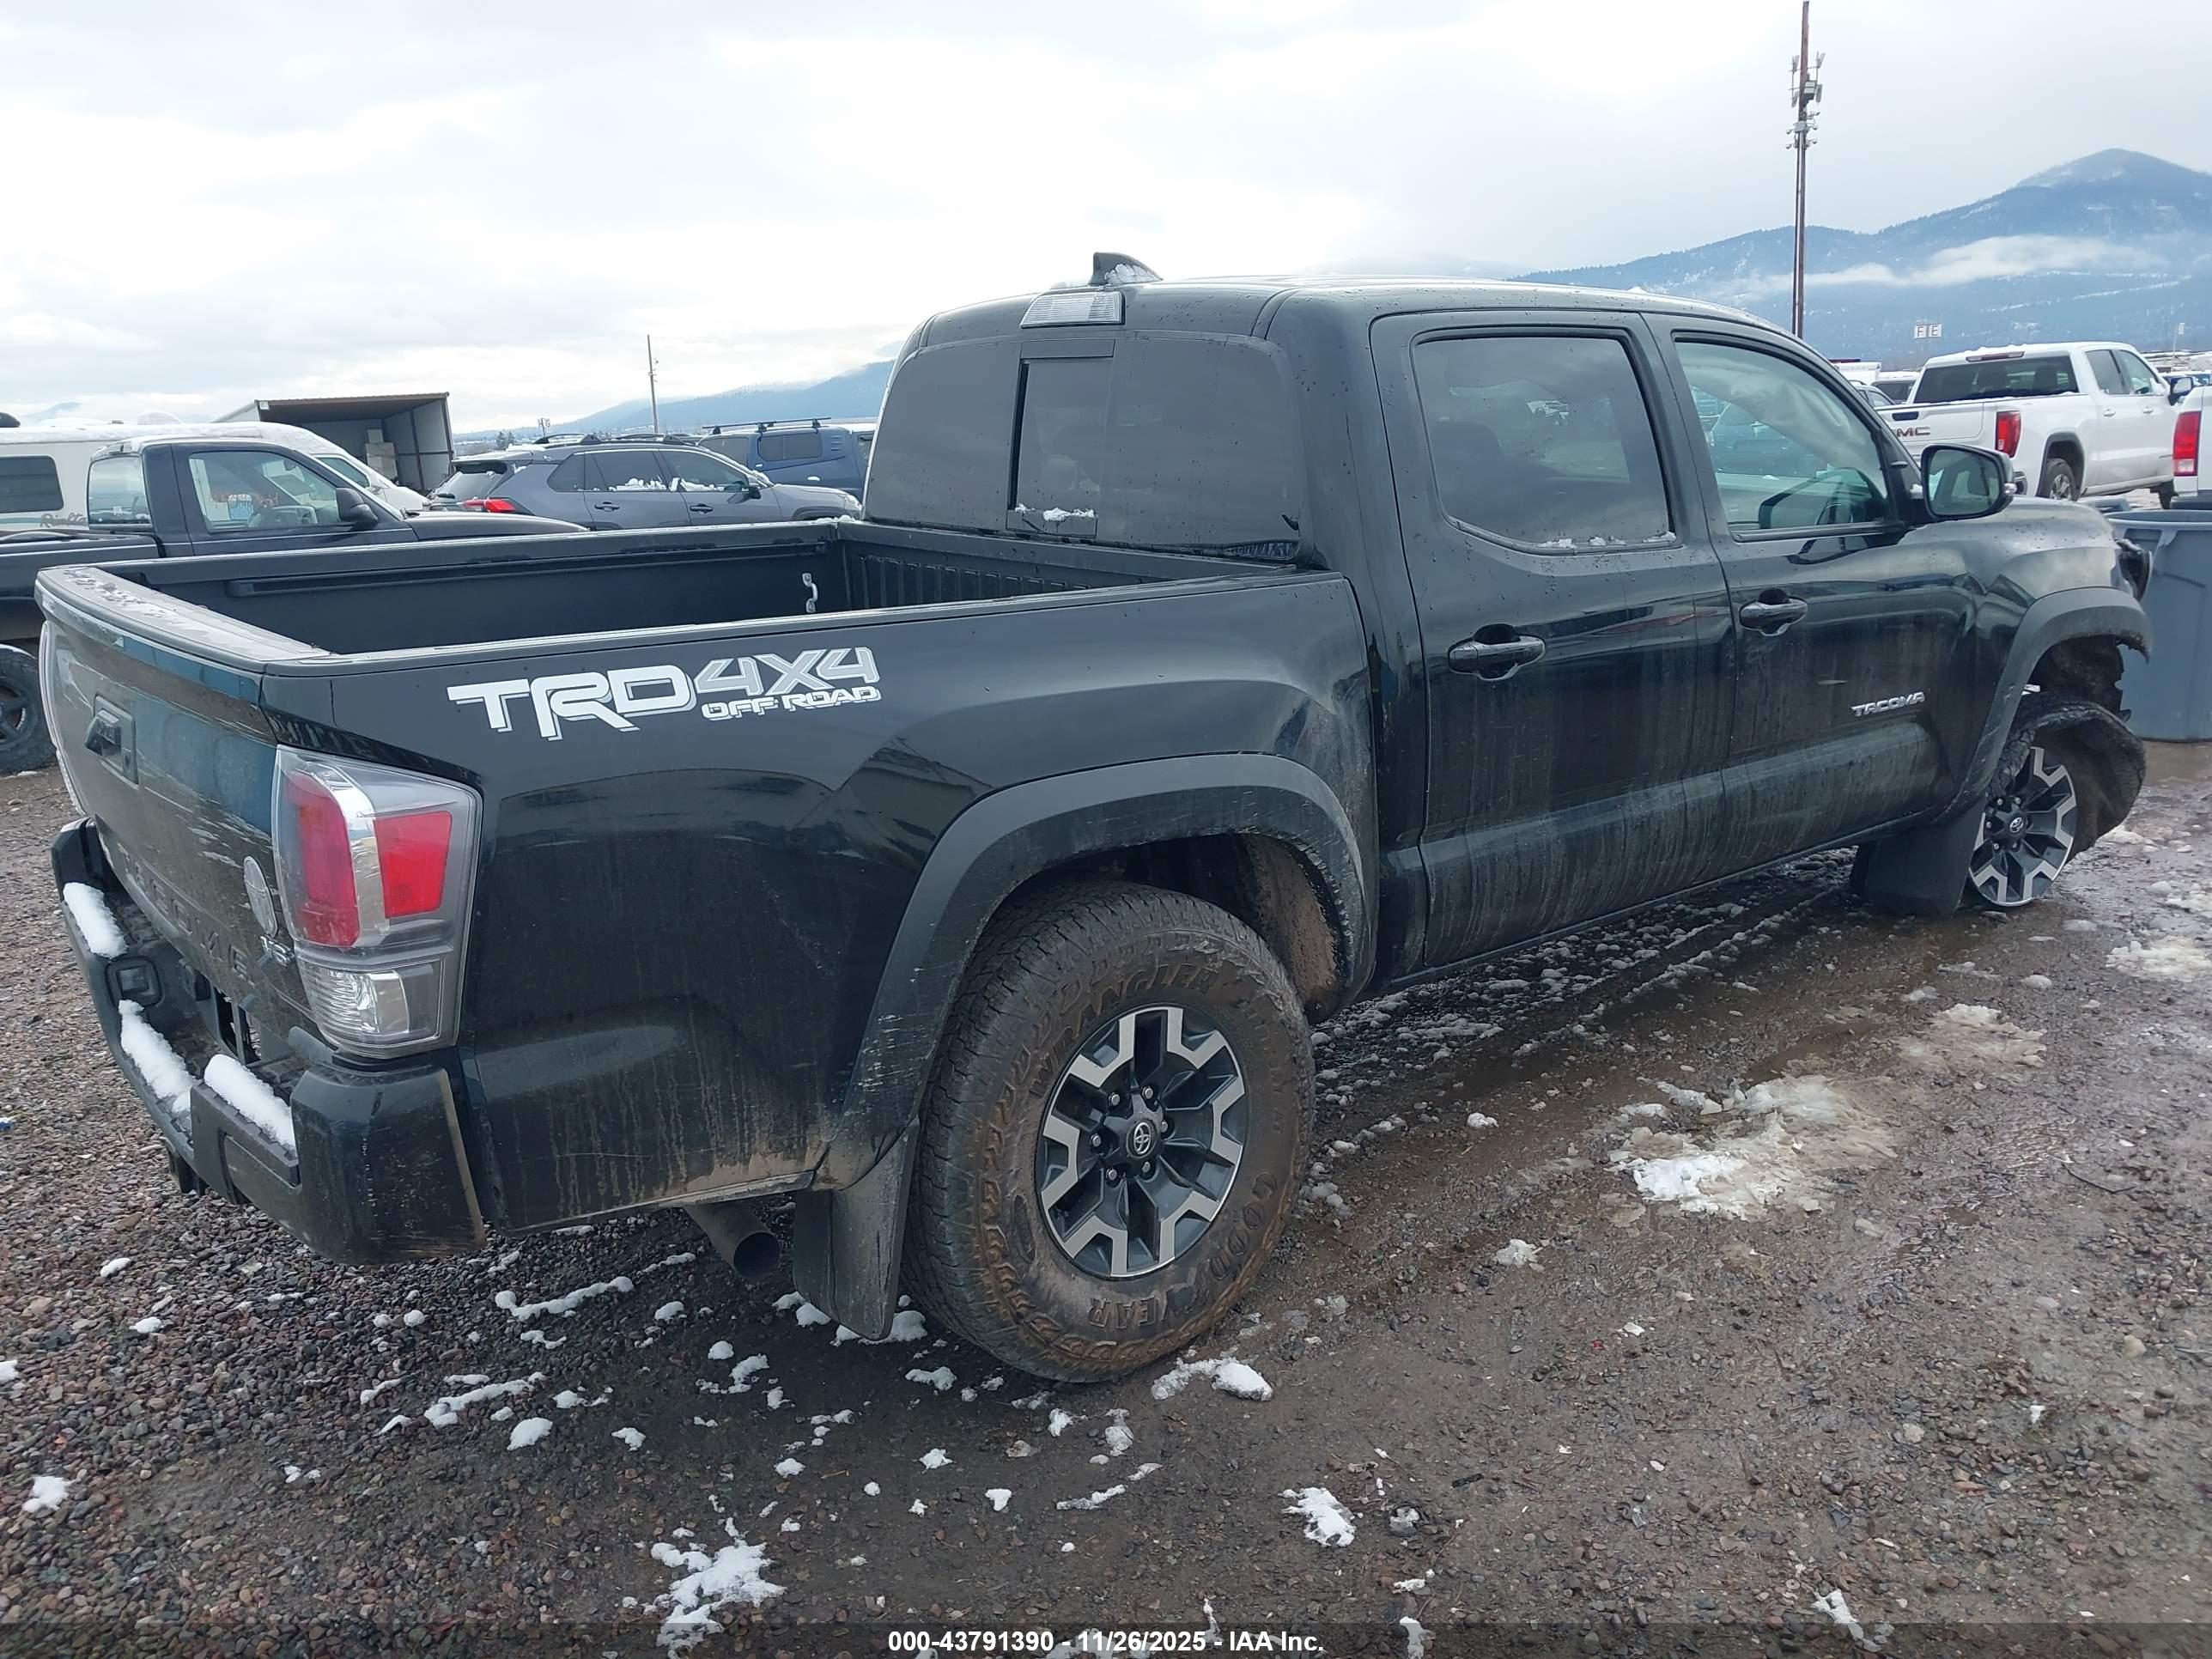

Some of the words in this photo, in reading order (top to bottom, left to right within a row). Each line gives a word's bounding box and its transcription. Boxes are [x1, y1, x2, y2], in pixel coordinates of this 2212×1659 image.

[1917, 326, 1924, 337] F
[1931, 325, 1939, 337] E
[1891, 426, 1930, 438] MC
[447, 665, 697, 741] TRD
[693, 647, 880, 696] 4X4
[701, 696, 779, 721] OFF
[781, 685, 882, 712] ROAD
[1850, 690, 1925, 717] TACOMA
